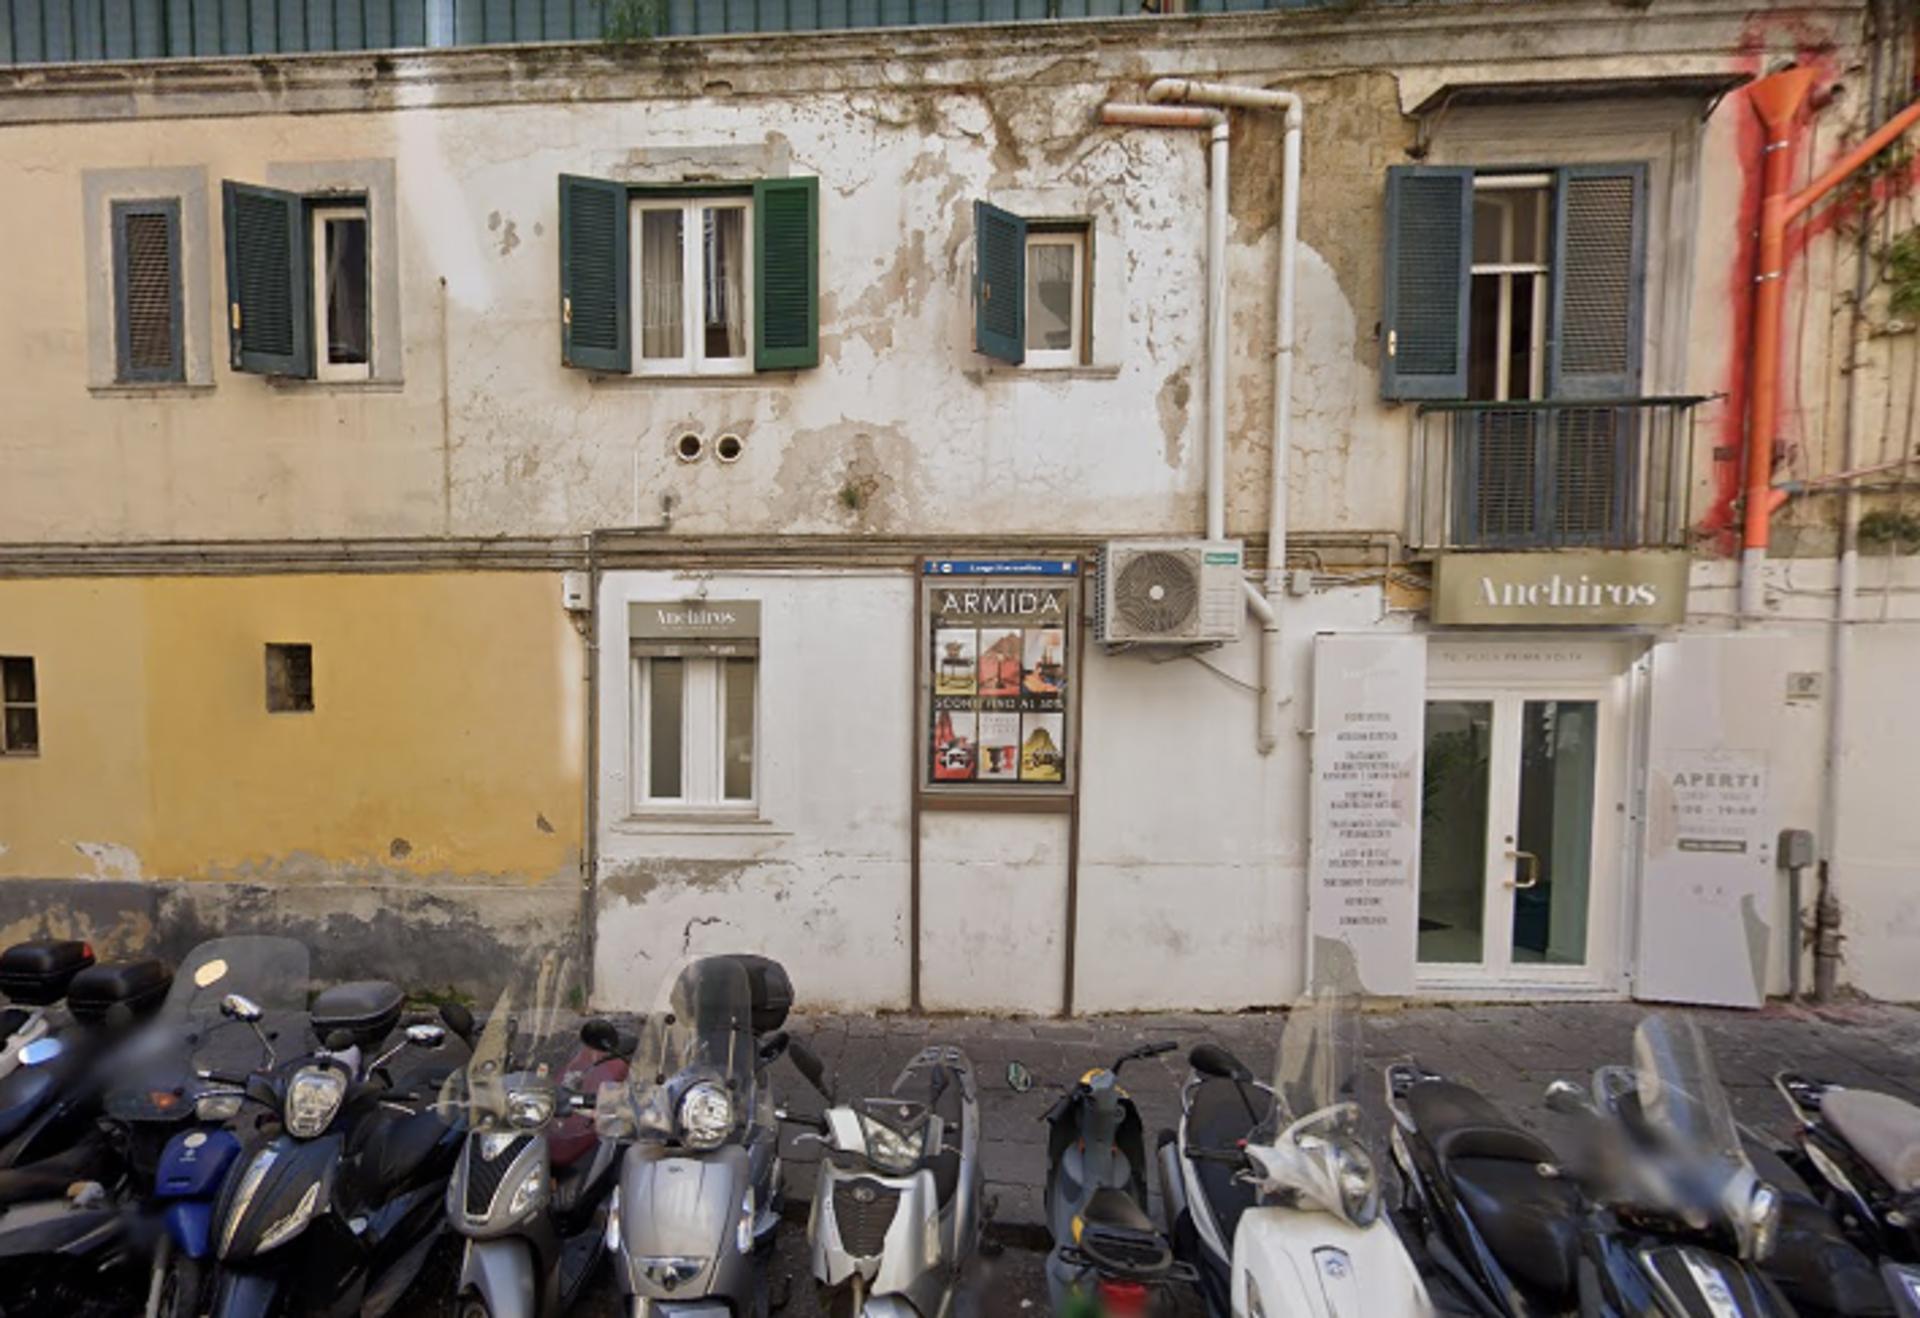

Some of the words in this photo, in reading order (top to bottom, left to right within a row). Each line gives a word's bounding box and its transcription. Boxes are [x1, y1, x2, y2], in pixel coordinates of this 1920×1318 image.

[1476, 574, 1656, 606] Anchiros
[941, 592, 1062, 614] ARMIDA
[656, 608, 736, 624] Anchiros
[1672, 772, 1759, 787] APERTI
